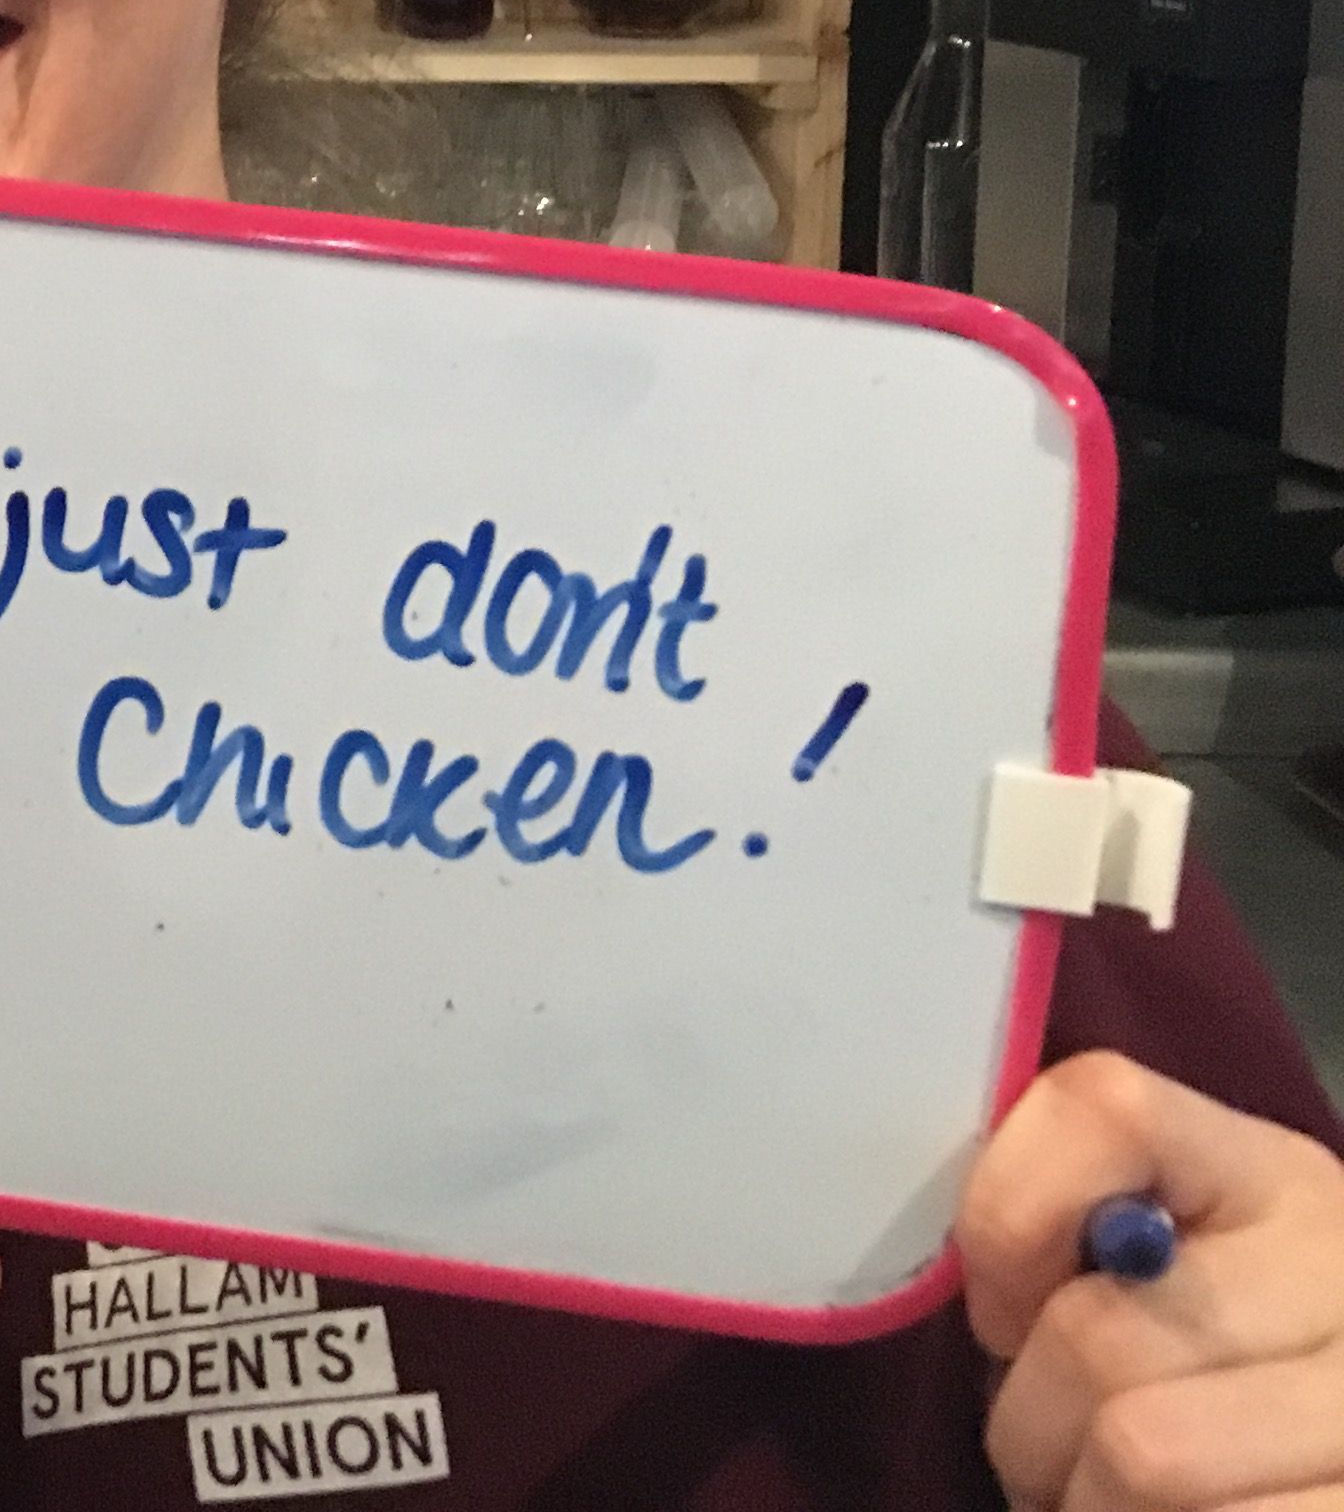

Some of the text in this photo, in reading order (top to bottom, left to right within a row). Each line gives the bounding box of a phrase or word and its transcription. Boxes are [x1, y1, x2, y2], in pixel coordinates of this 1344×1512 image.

[382, 519, 719, 702] don't
[63, 1261, 305, 1336] HALLAM
[32, 1320, 371, 1420] STUDENTS'
[201, 1408, 434, 1487] UNION
